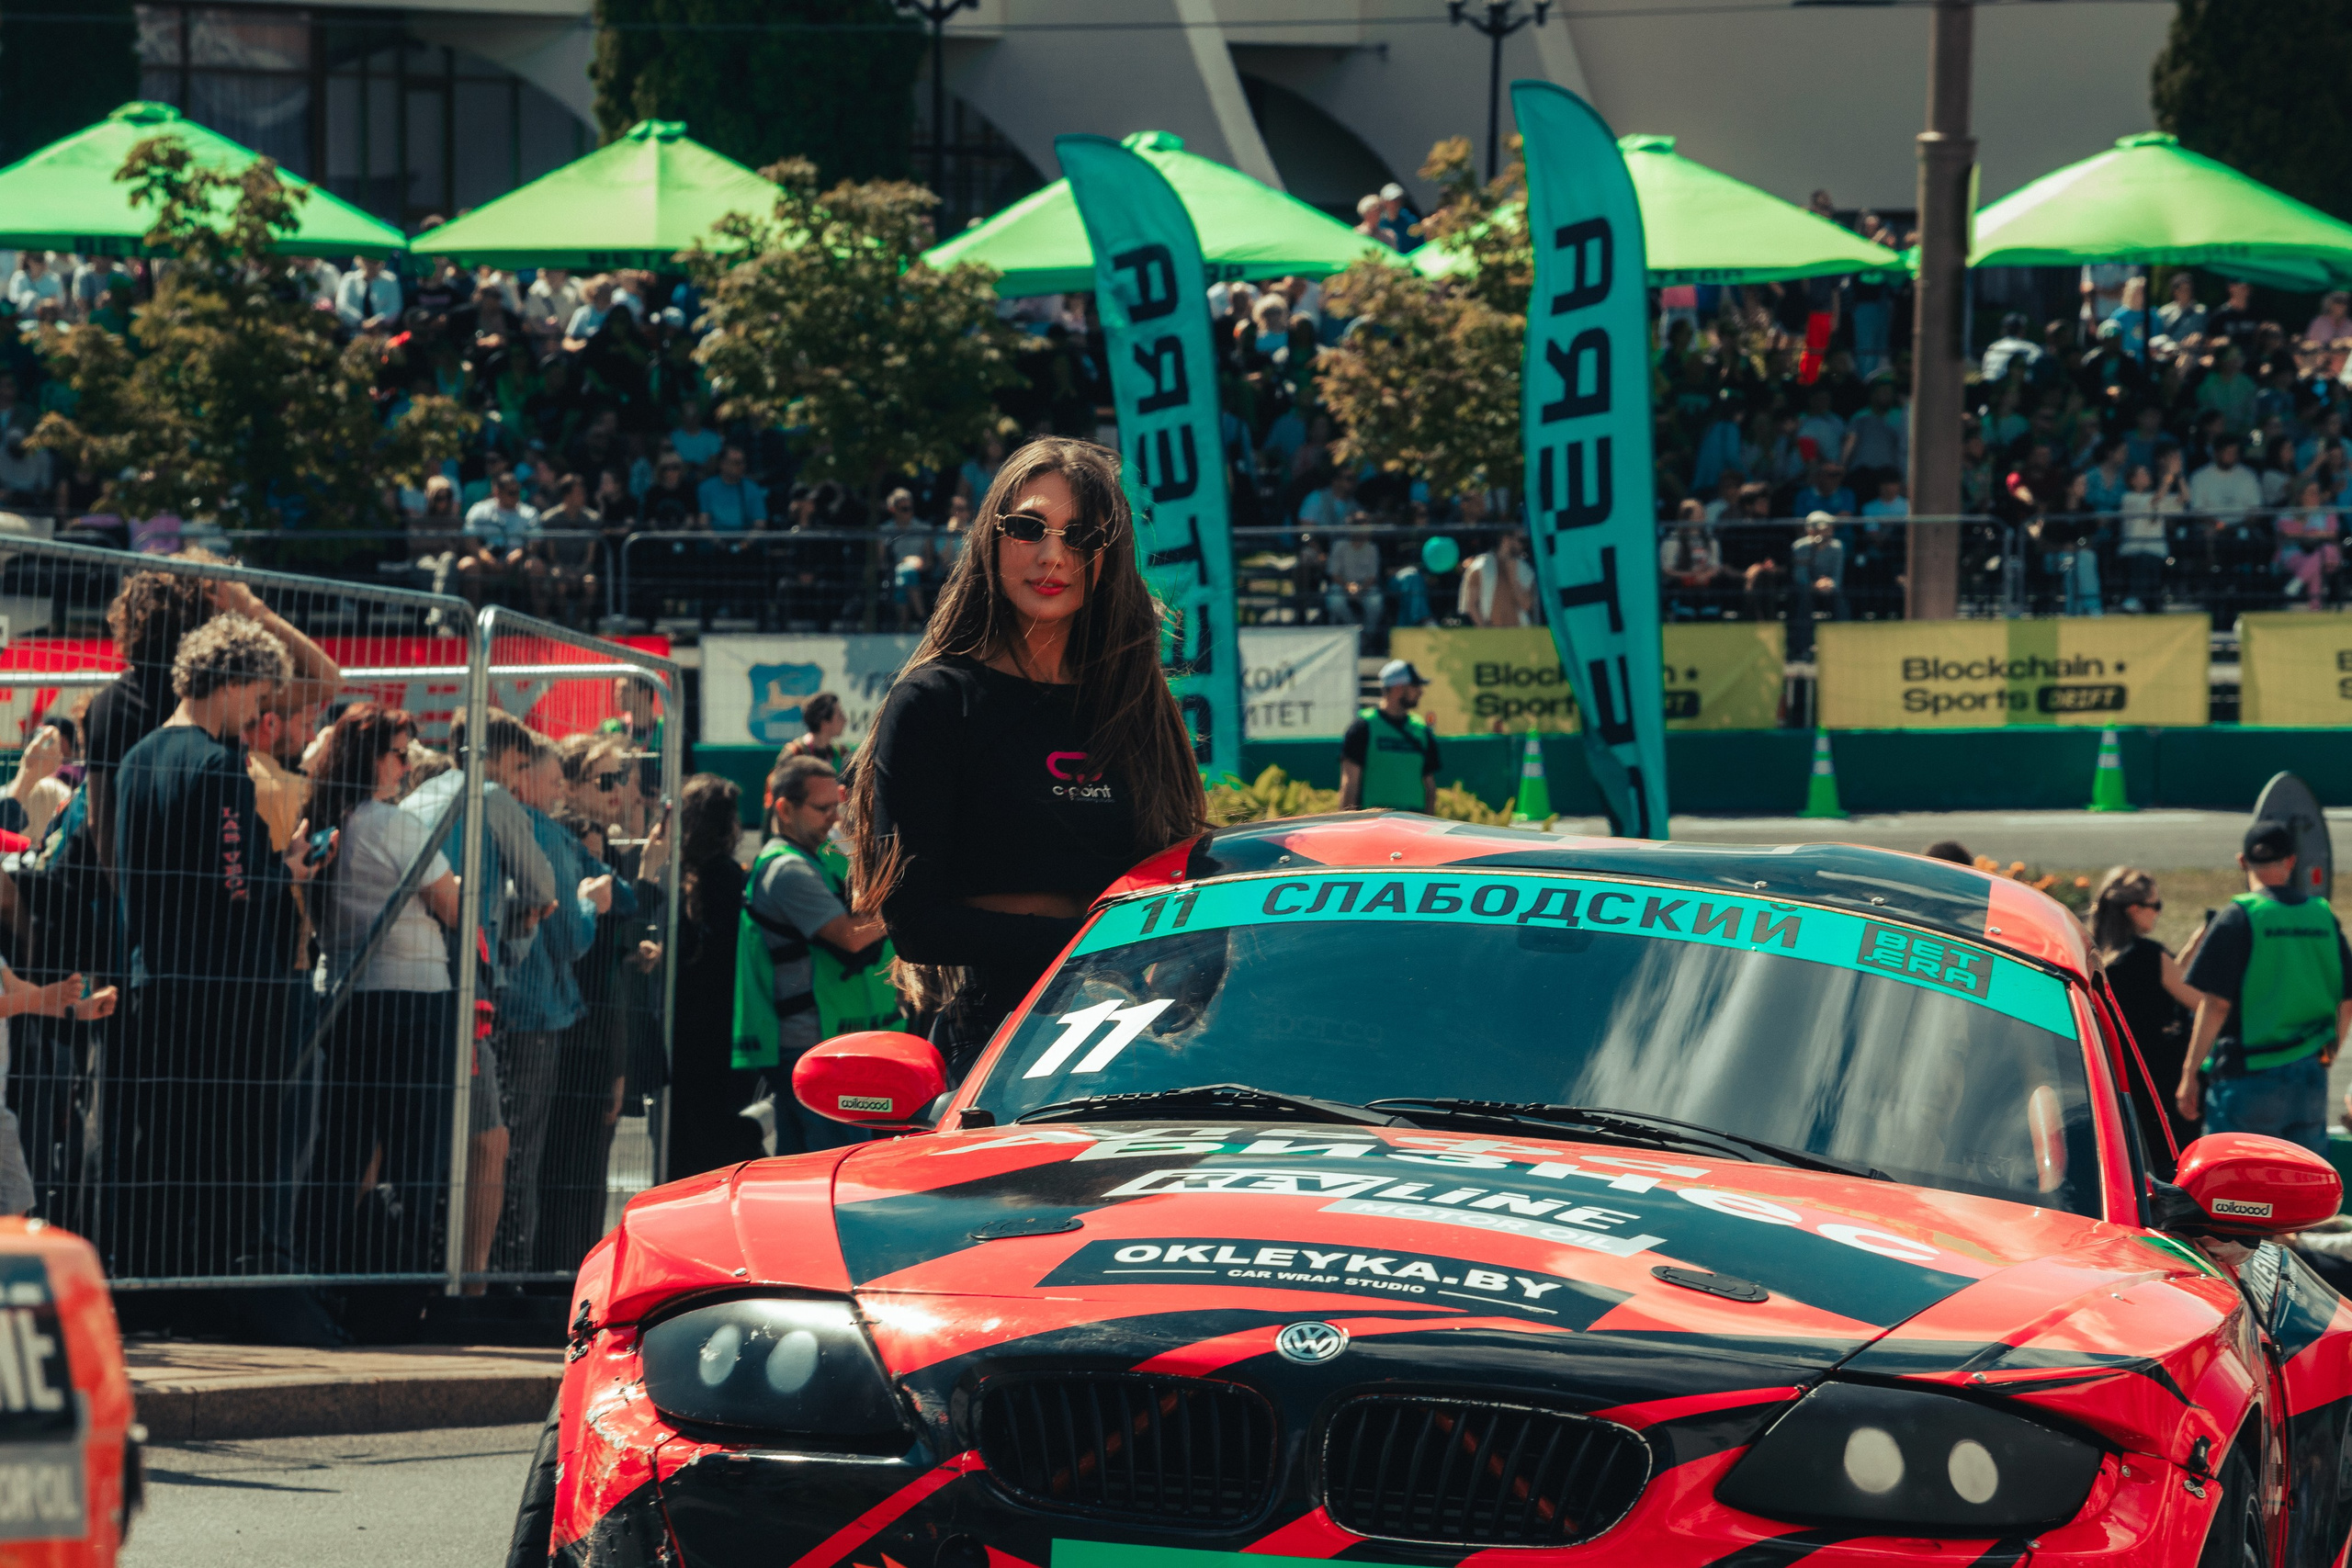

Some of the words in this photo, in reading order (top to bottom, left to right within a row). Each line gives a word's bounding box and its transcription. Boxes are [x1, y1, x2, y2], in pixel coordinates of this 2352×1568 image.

[1903, 655, 2105, 682] Blockchain
[1904, 687, 2029, 717] Sports
[1140, 889, 1201, 935] 11
[1262, 881, 1803, 950] СЛАБОДСКИЙ
[1863, 947, 1978, 990] ERA
[1874, 930, 1981, 970] BET
[1022, 998, 1176, 1079] 11
[841, 1097, 889, 1111] wilwood
[1351, 1202, 1531, 1232] MOTOR
[1539, 1227, 1612, 1250] OIL
[2215, 1201, 2270, 1216] wilwood
[1113, 1244, 1563, 1300] OKLEYKA.BY
[1227, 1269, 1272, 1280] CAR
[1277, 1271, 1340, 1284] WRAP
[1344, 1278, 1427, 1294] STUDIO
